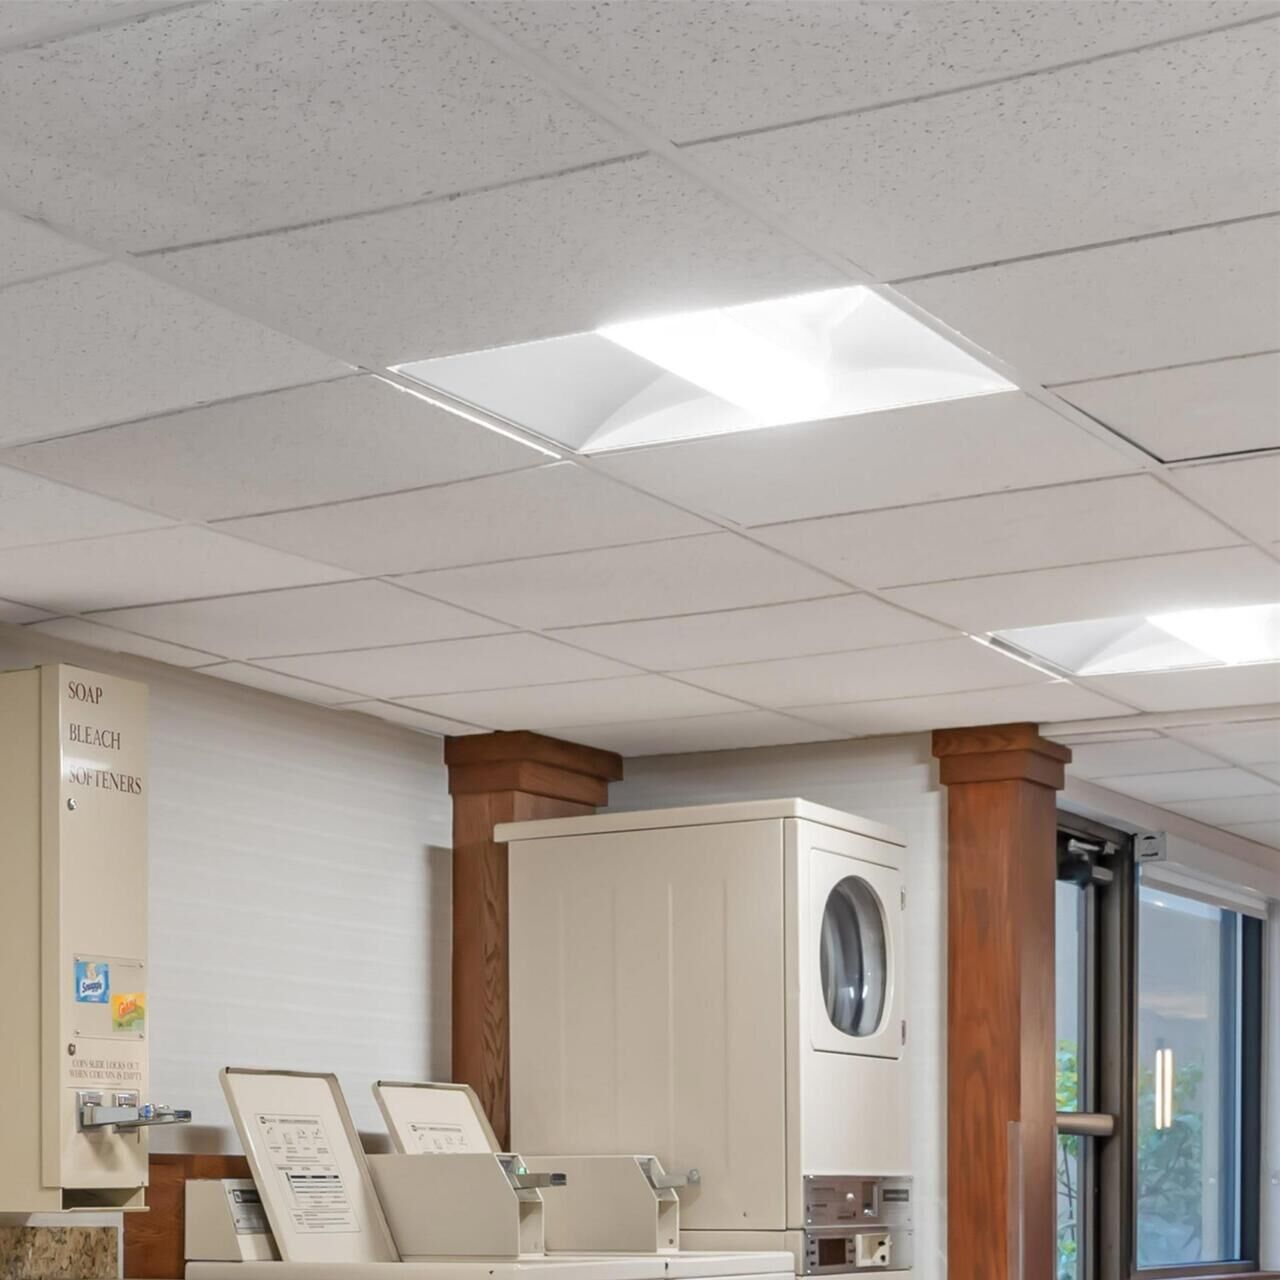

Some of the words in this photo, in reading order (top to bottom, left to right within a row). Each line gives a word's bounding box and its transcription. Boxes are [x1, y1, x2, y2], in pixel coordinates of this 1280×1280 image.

[68, 681, 103, 704] SOAP
[69, 723, 121, 750] BLEACH
[69, 765, 142, 795] SOFTENERS
[82, 979, 102, 993] Snuggle
